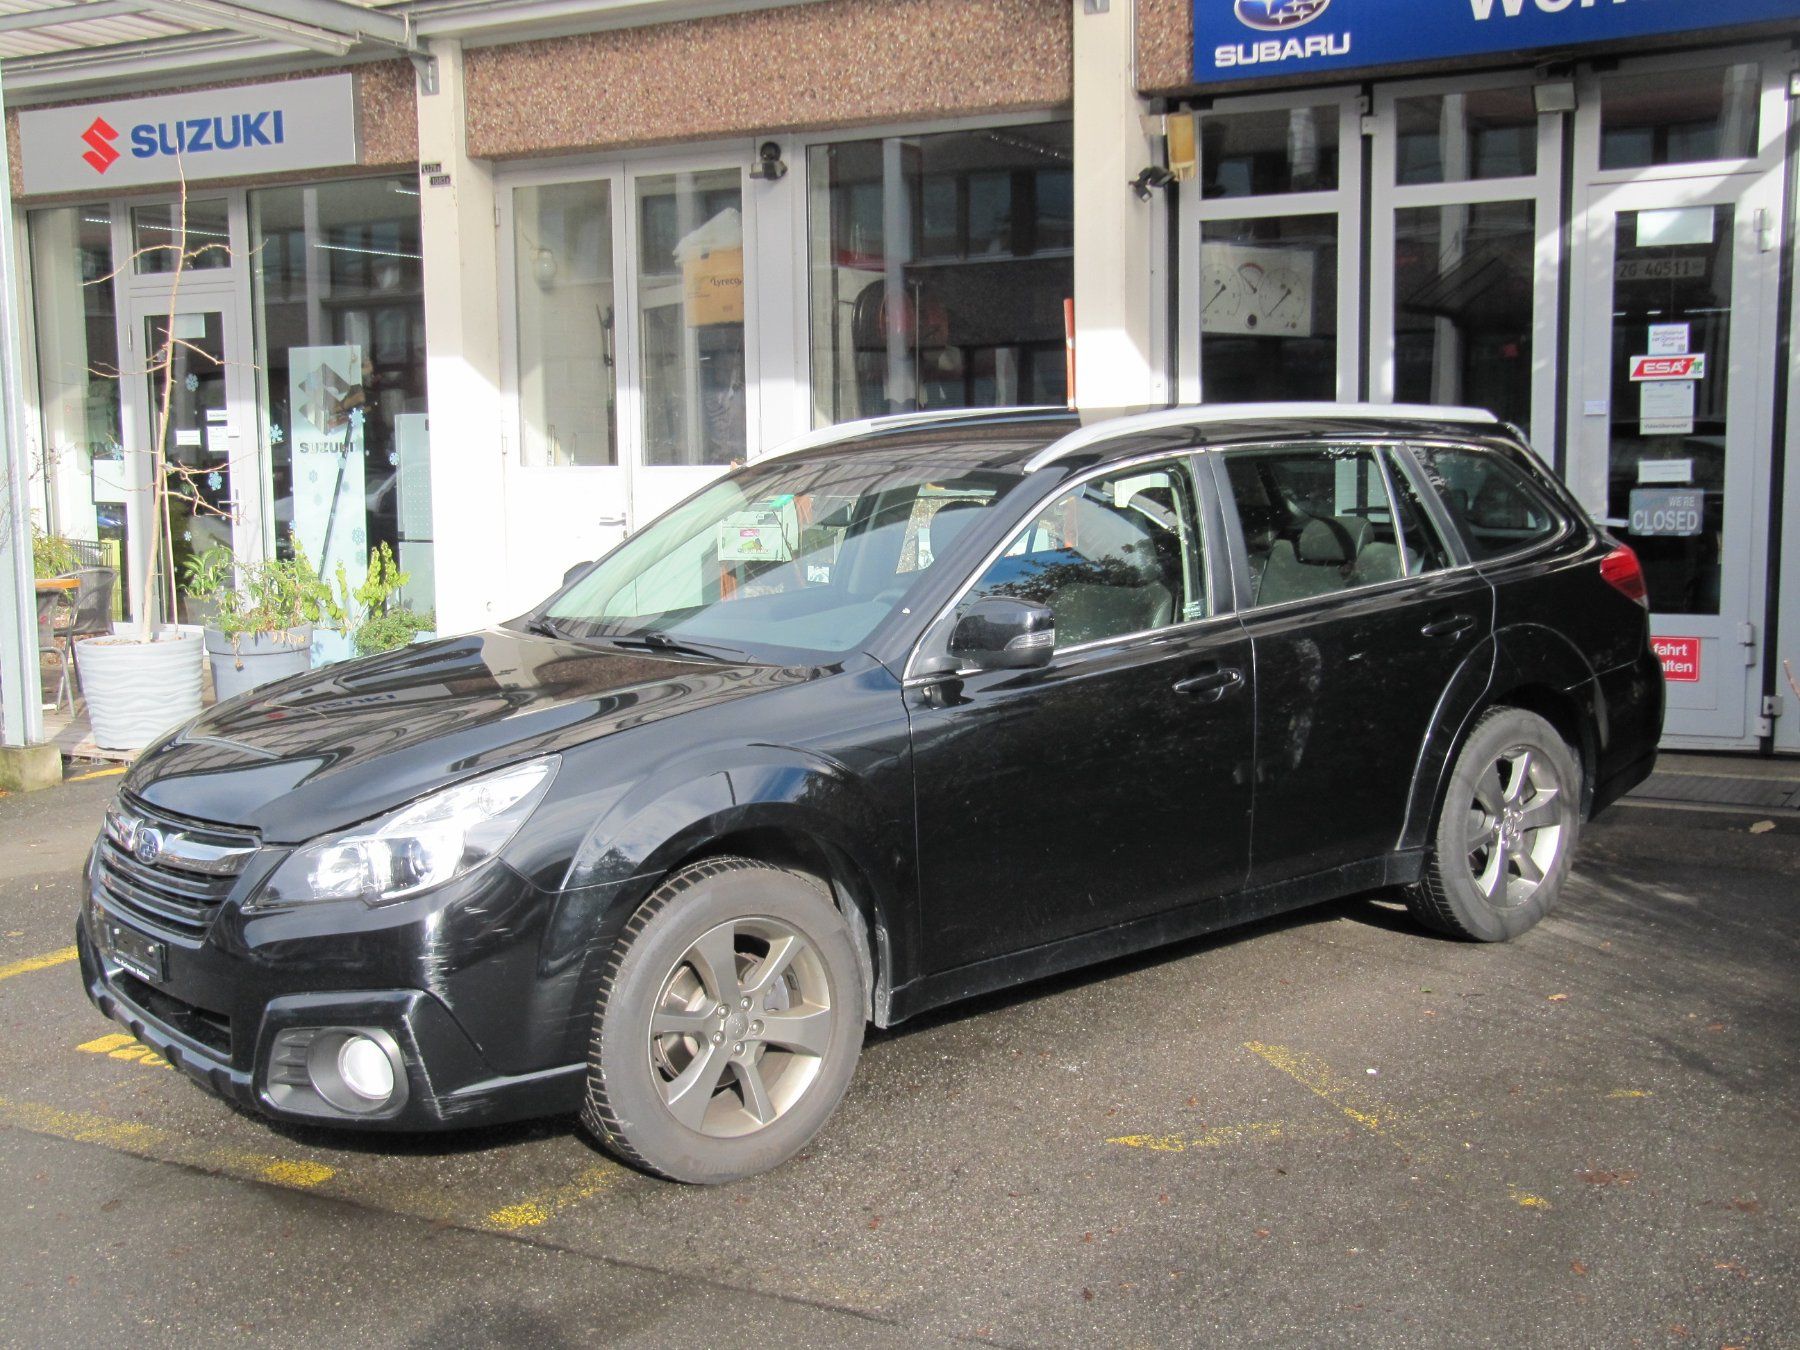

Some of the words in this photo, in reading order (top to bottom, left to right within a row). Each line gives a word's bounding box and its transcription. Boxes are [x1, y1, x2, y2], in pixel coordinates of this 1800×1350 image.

[1214, 32, 1351, 68] SUBARU
[130, 110, 284, 158] SUZUKI
[1633, 510, 1698, 531] CLOSED
